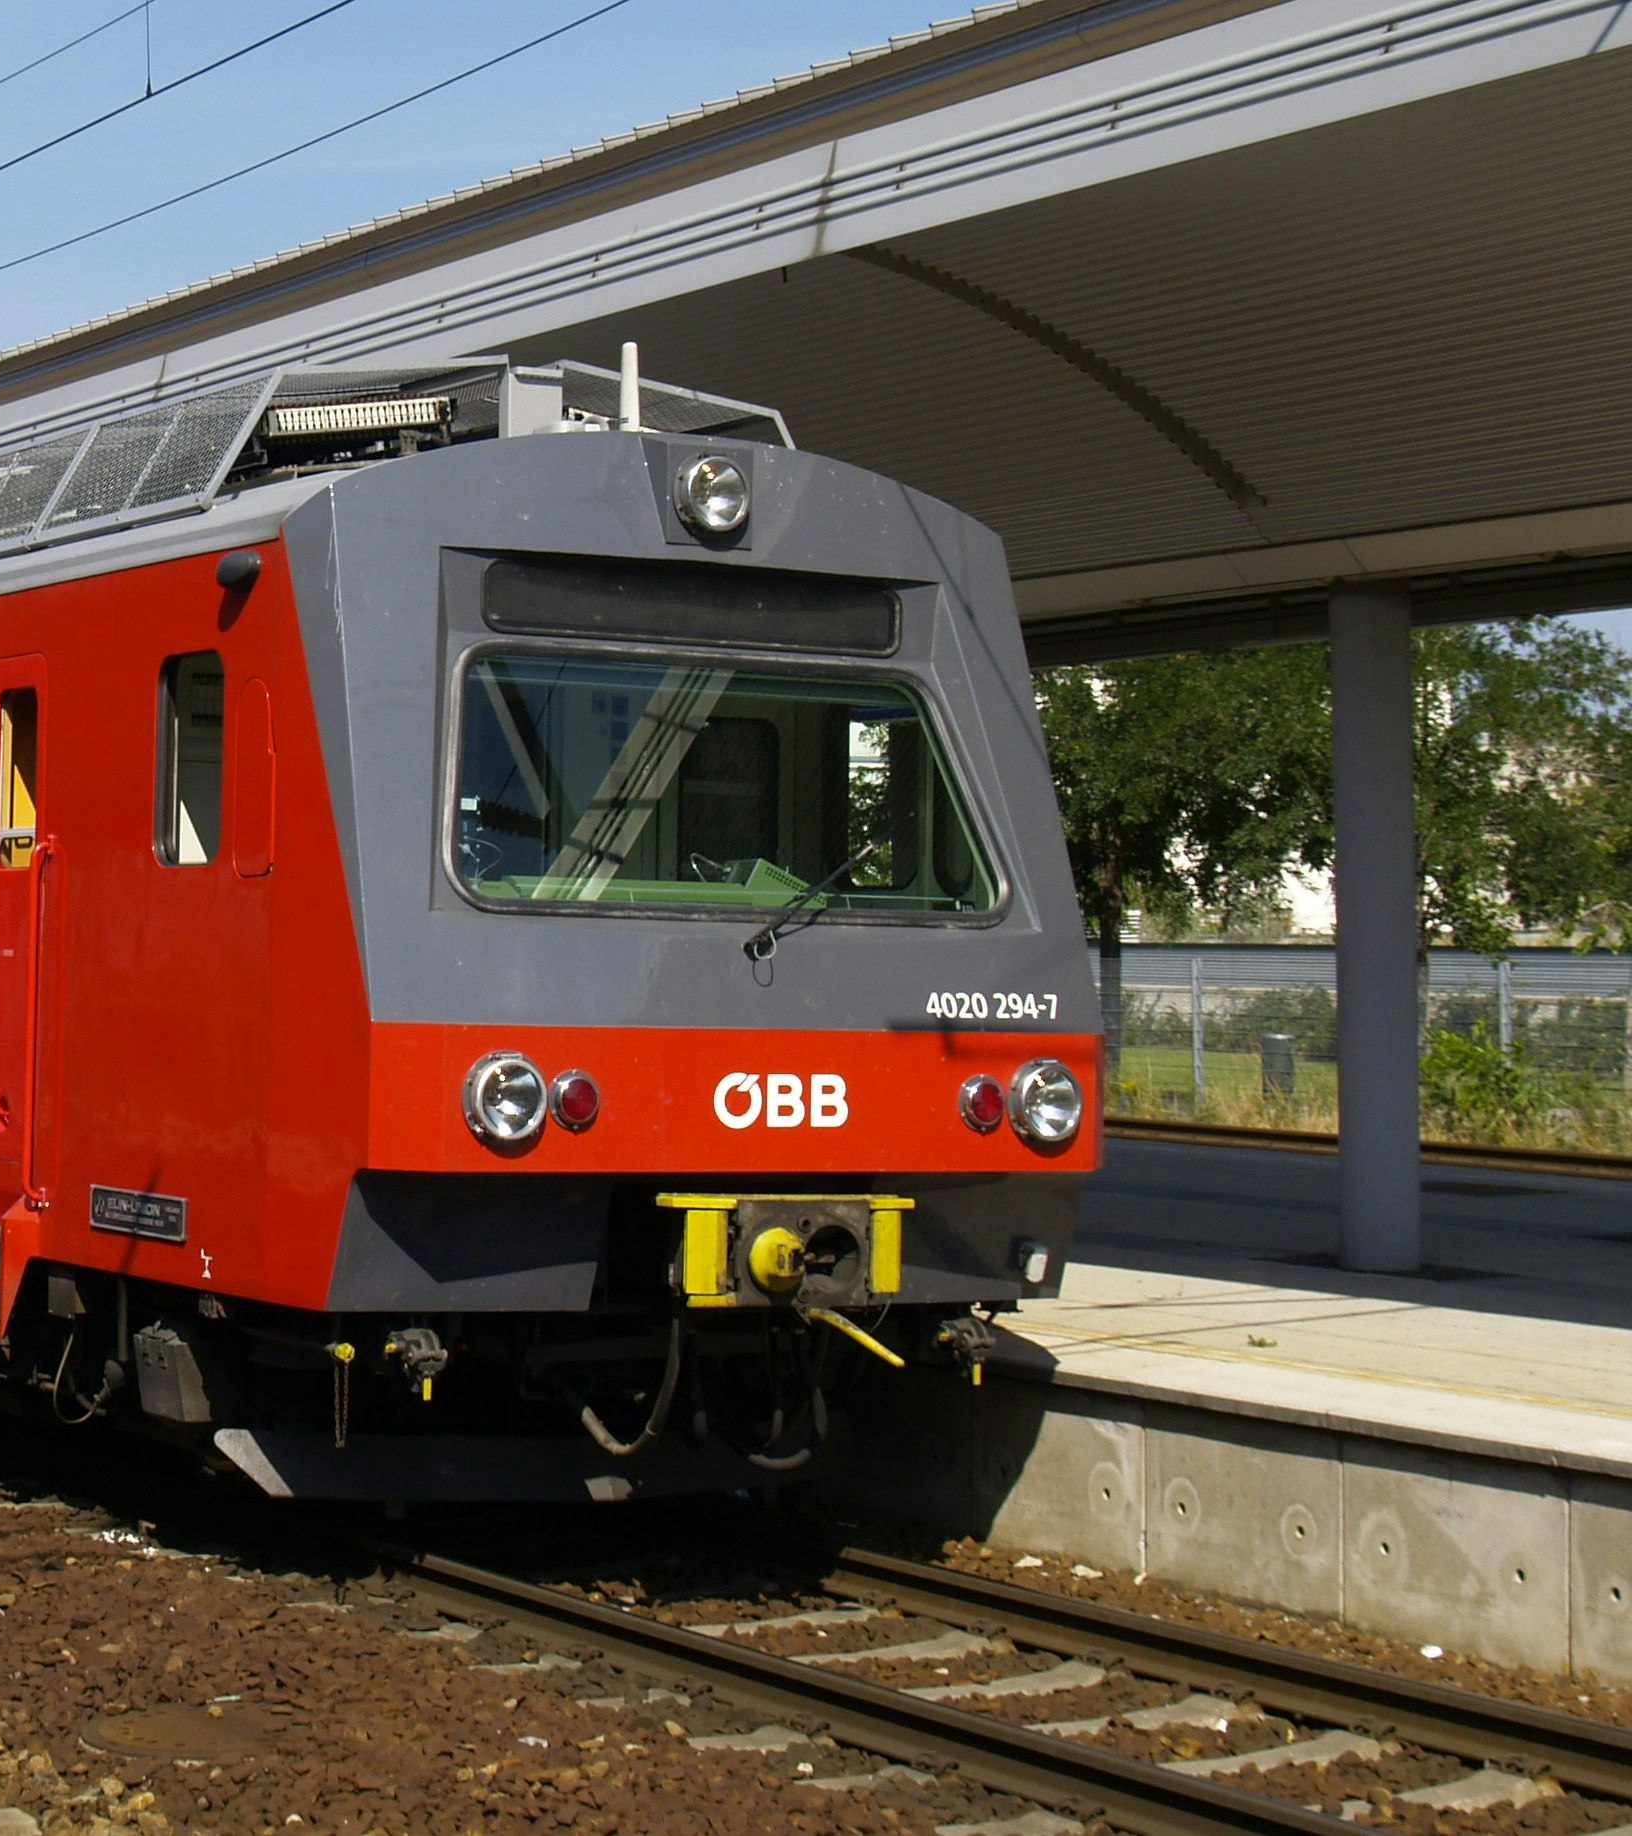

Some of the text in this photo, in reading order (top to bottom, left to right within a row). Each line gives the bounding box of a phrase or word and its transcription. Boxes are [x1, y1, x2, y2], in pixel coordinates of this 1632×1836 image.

[925, 991, 1058, 1020] 4020 294-7
[712, 1071, 850, 1130] ÖBB
